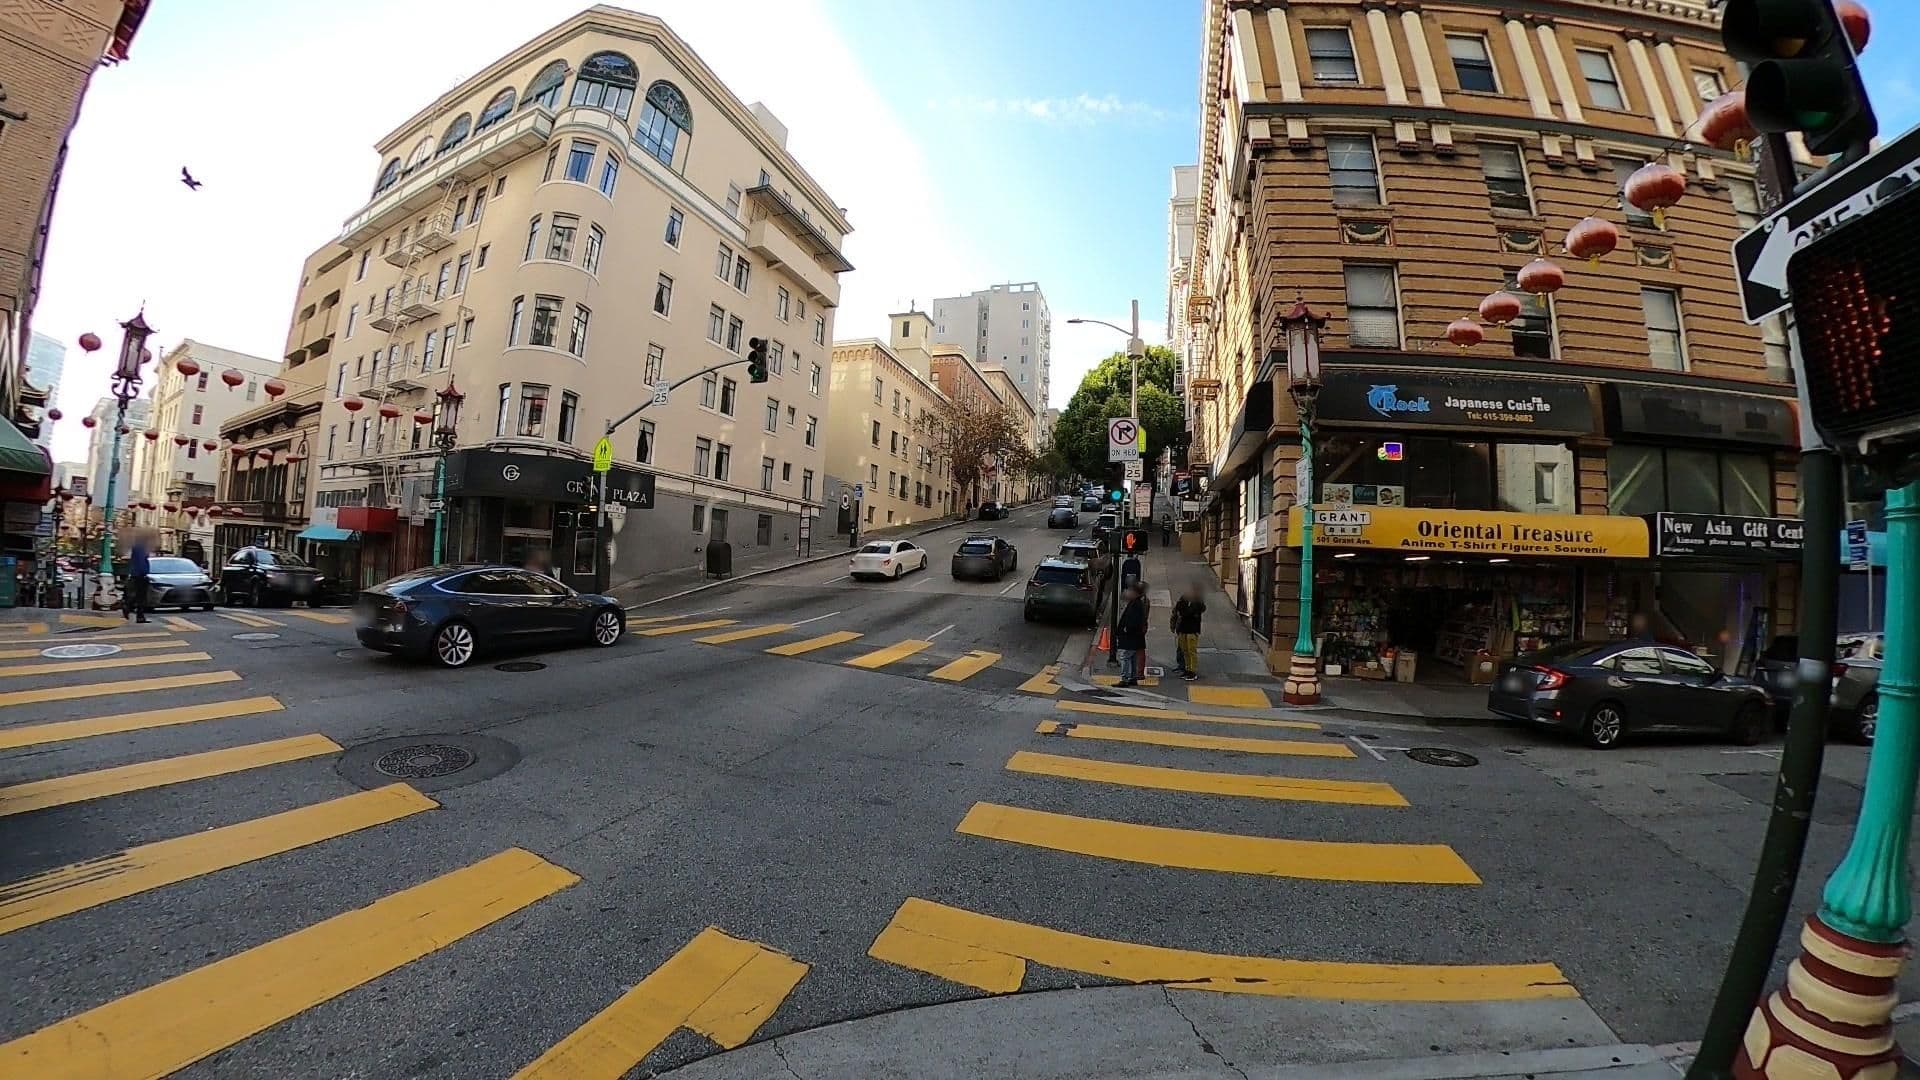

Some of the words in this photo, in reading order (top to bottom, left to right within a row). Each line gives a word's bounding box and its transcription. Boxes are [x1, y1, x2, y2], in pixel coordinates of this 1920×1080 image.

[655, 392, 667, 403] 25
[1445, 396, 1504, 411] Japanese
[1126, 469, 1141, 478] 25
[613, 488, 647, 503] PLAZA
[1319, 512, 1367, 522] GRANT
[1417, 520, 1502, 540] Oriental
[1510, 524, 1594, 543] Treasure
[1663, 517, 1693, 533] New
[1705, 519, 1733, 535] Asia
[1743, 521, 1768, 538] Gift
[1777, 523, 1804, 539] Cent
[1401, 538, 1445, 549] Anime
[1449, 540, 1497, 550] T-Shirt
[1501, 542, 1550, 553] Figures
[1554, 544, 1608, 554] Souvenir
